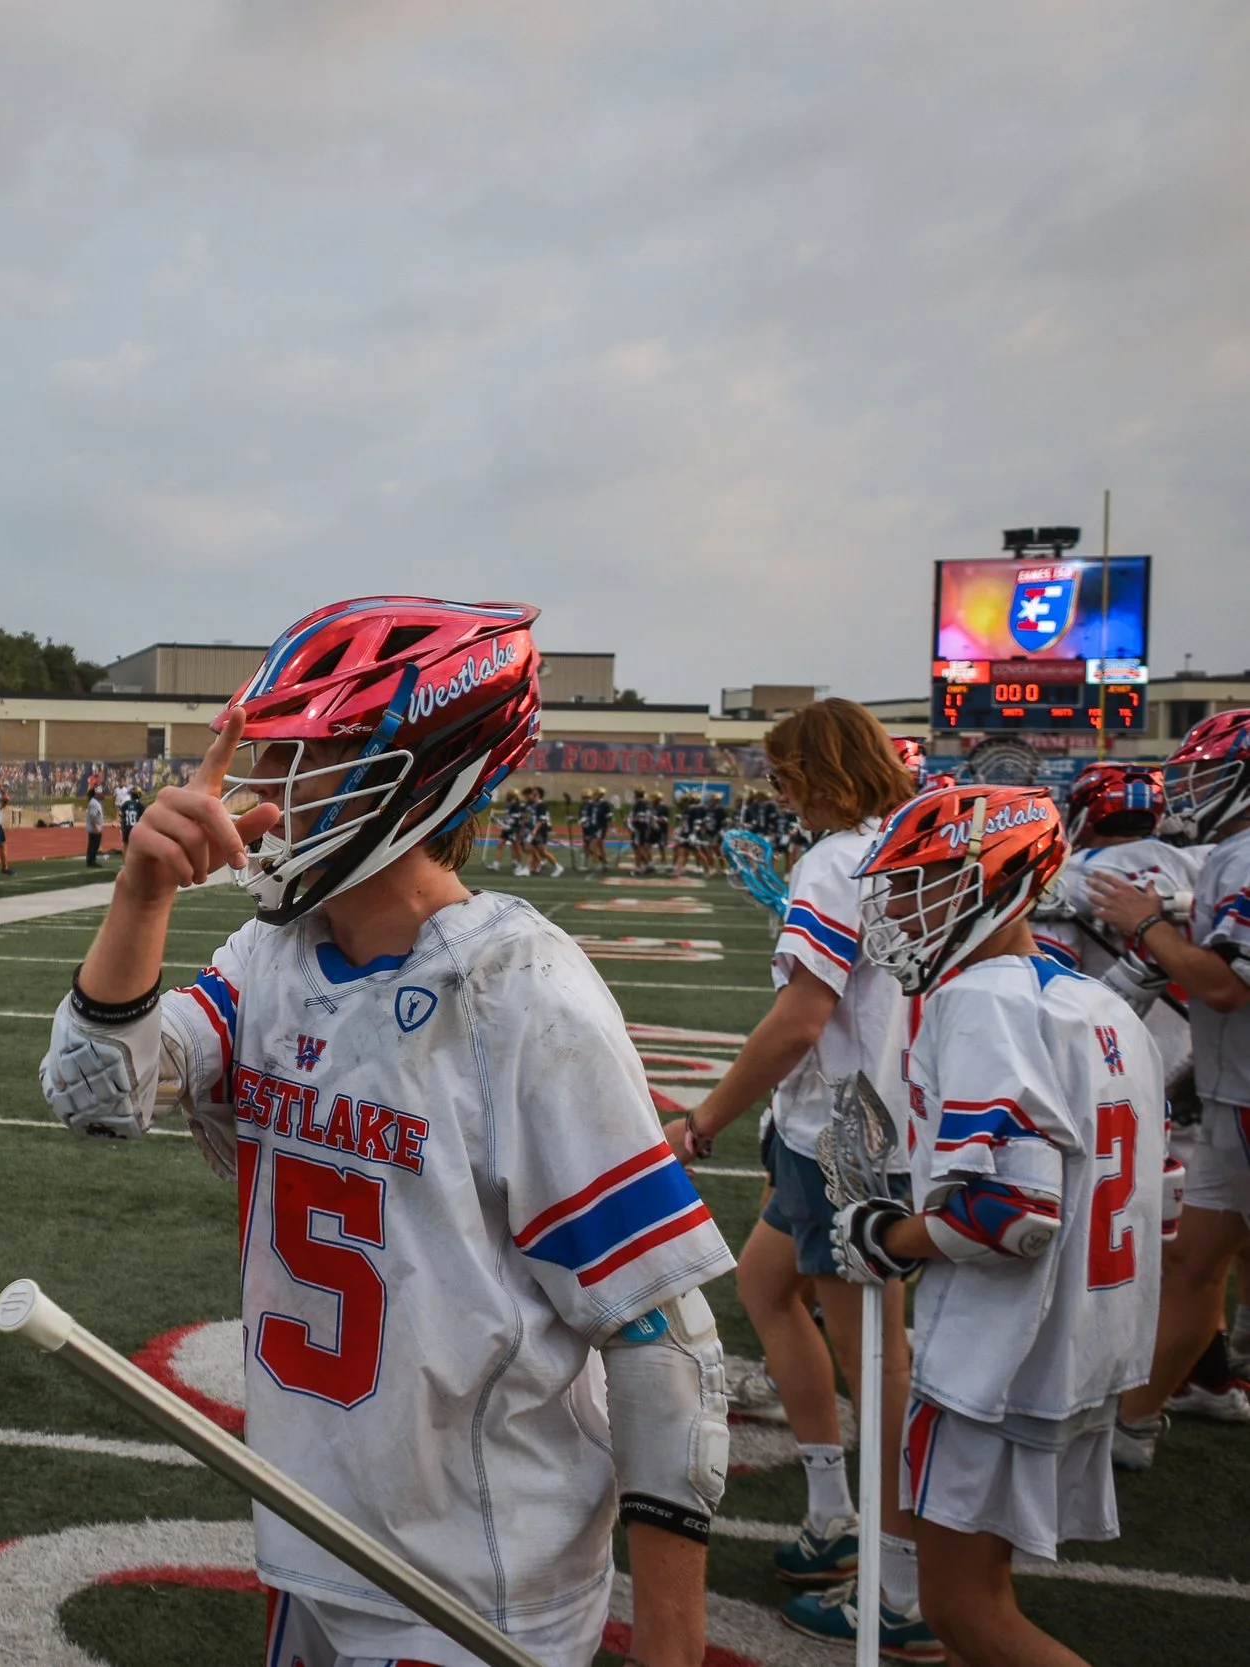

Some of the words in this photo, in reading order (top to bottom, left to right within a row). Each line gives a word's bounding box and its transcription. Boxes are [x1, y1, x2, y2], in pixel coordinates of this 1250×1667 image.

[407, 638, 517, 725] Westlake
[945, 694, 964, 707] 11
[1128, 692, 1139, 707] 7
[330, 722, 373, 737] XRS
[124, 809, 138, 826] 10
[940, 799, 1050, 848] Wstlake
[294, 1033, 328, 1073] W
[233, 1060, 430, 1176] ESTLAKE
